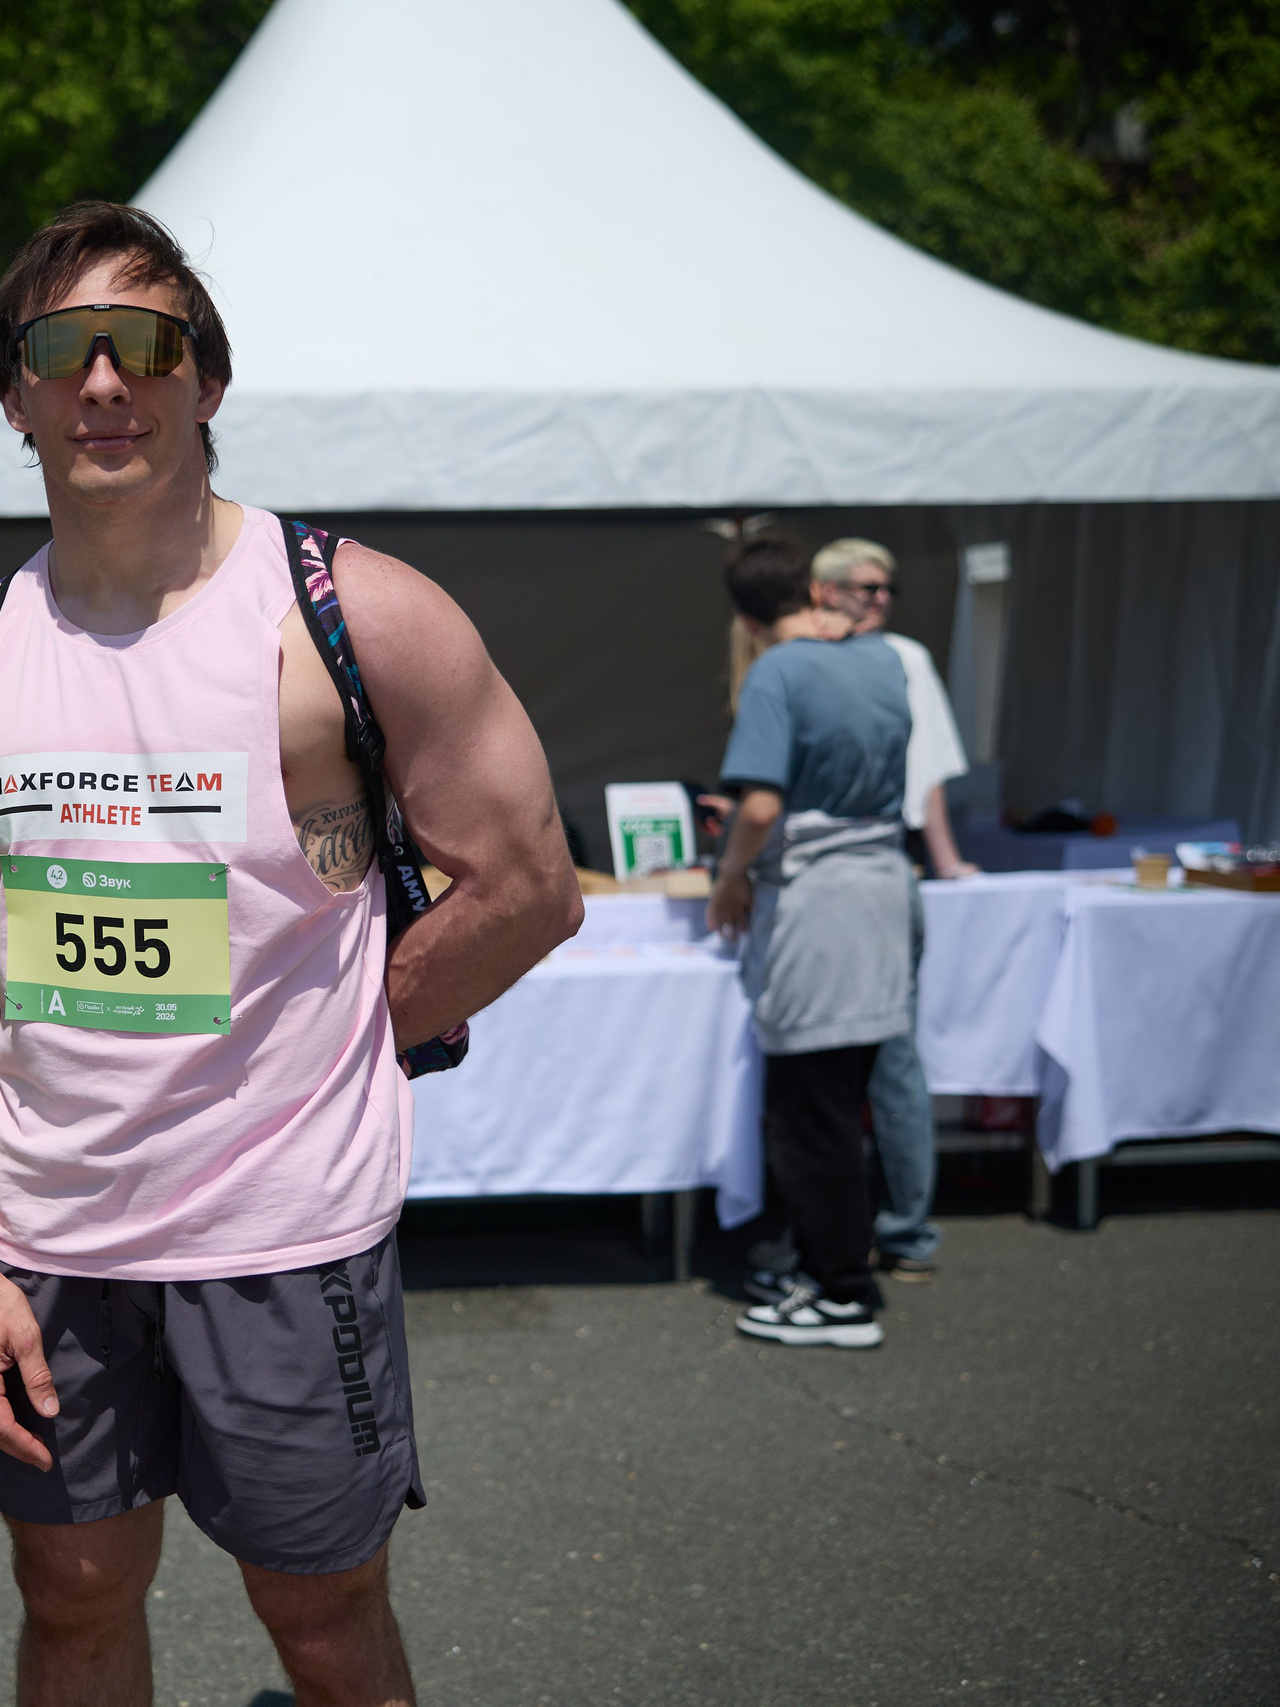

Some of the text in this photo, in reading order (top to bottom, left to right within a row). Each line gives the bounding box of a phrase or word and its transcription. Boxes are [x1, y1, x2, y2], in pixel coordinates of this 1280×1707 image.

[147, 772, 222, 793] TEAM
[60, 803, 141, 826] ATHLETE
[50, 869, 64, 881] 4,2
[99, 875, 132, 890] Звук
[55, 912, 171, 979] 555
[155, 1003, 177, 1012] 30.05
[155, 1012, 176, 1021] 2026
